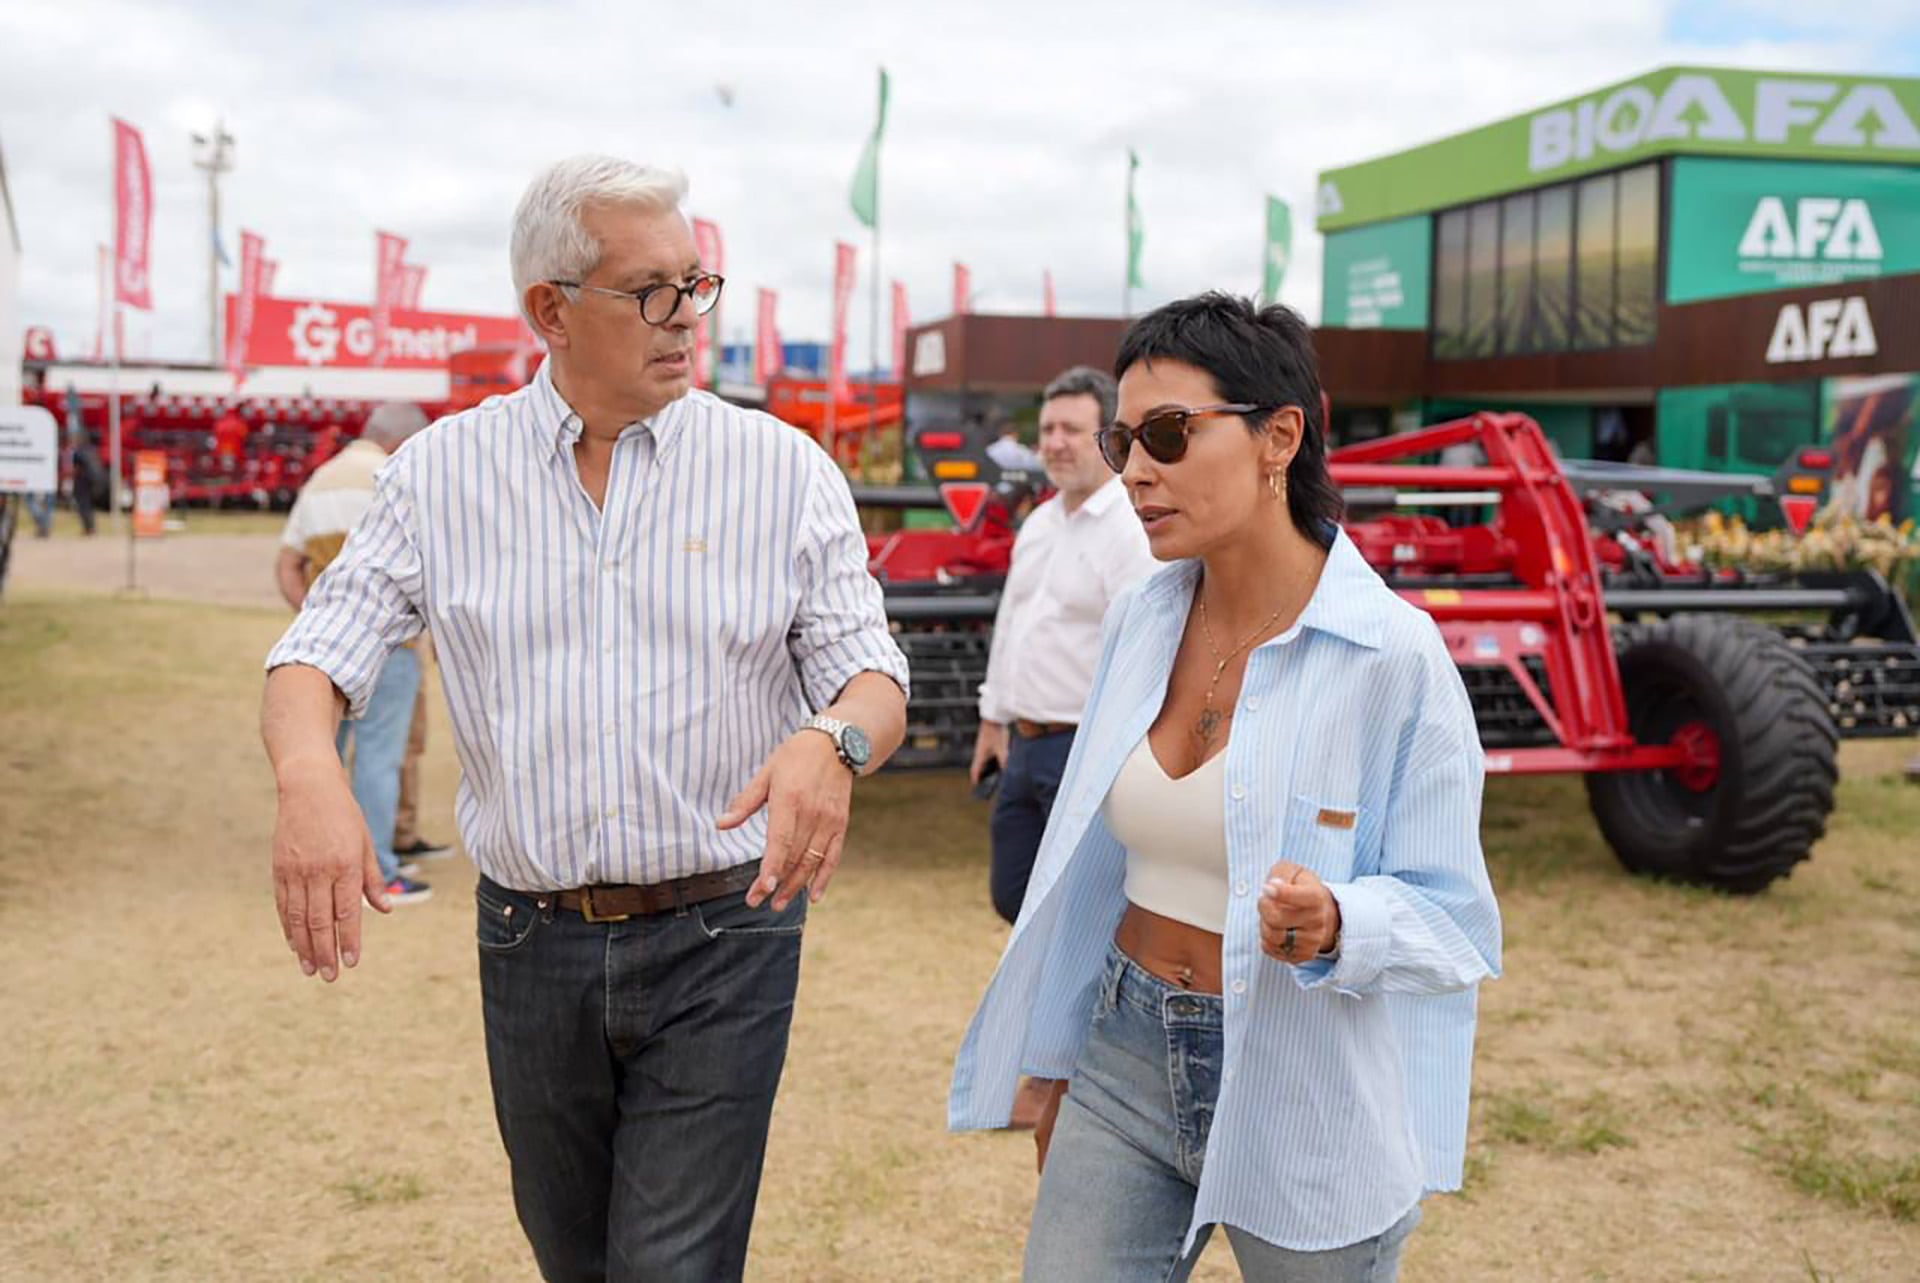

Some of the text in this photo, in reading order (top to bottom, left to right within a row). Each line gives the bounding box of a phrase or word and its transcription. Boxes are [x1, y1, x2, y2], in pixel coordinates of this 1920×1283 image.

[1738, 197, 1882, 259] AFA
[345, 316, 478, 361] Gmetal
[1766, 297, 1877, 362] AFA
